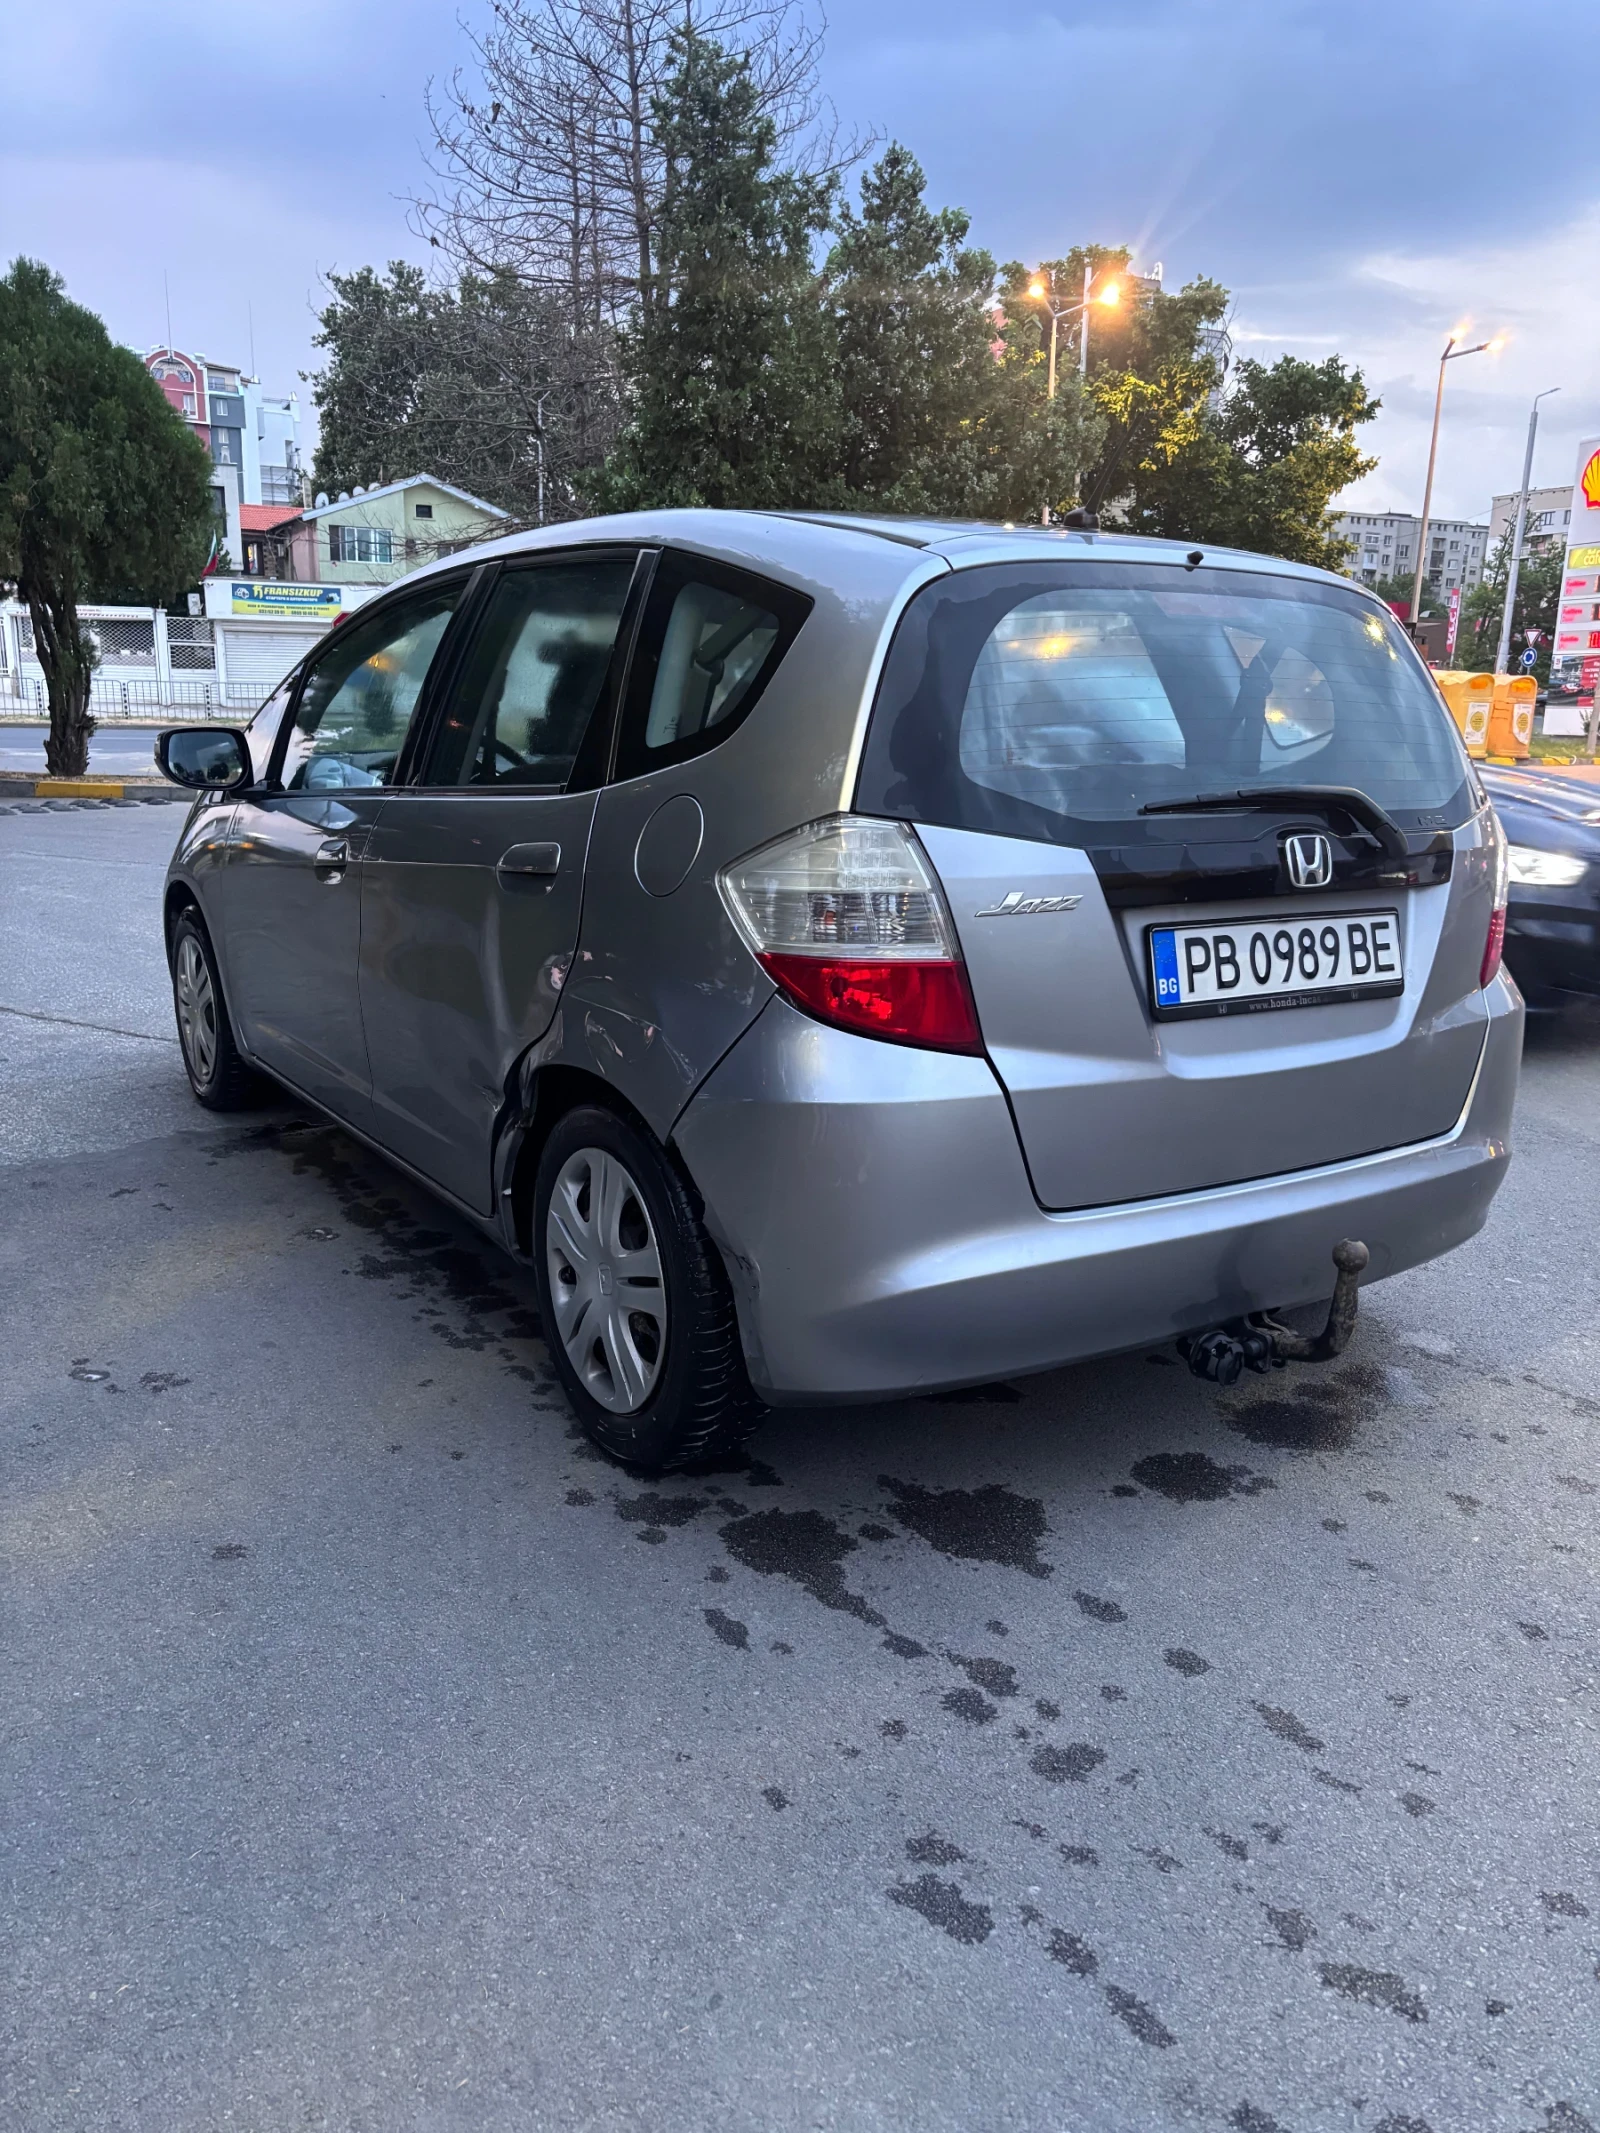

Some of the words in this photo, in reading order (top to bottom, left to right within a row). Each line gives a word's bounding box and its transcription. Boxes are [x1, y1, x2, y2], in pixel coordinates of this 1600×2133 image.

[1583, 549, 1600, 566] caf
[263, 586, 324, 597] FRANSIZKUP
[1184, 934, 1241, 994] PB
[1249, 925, 1340, 985] 0989
[1346, 921, 1396, 976] BE
[1158, 977, 1178, 995] BG
